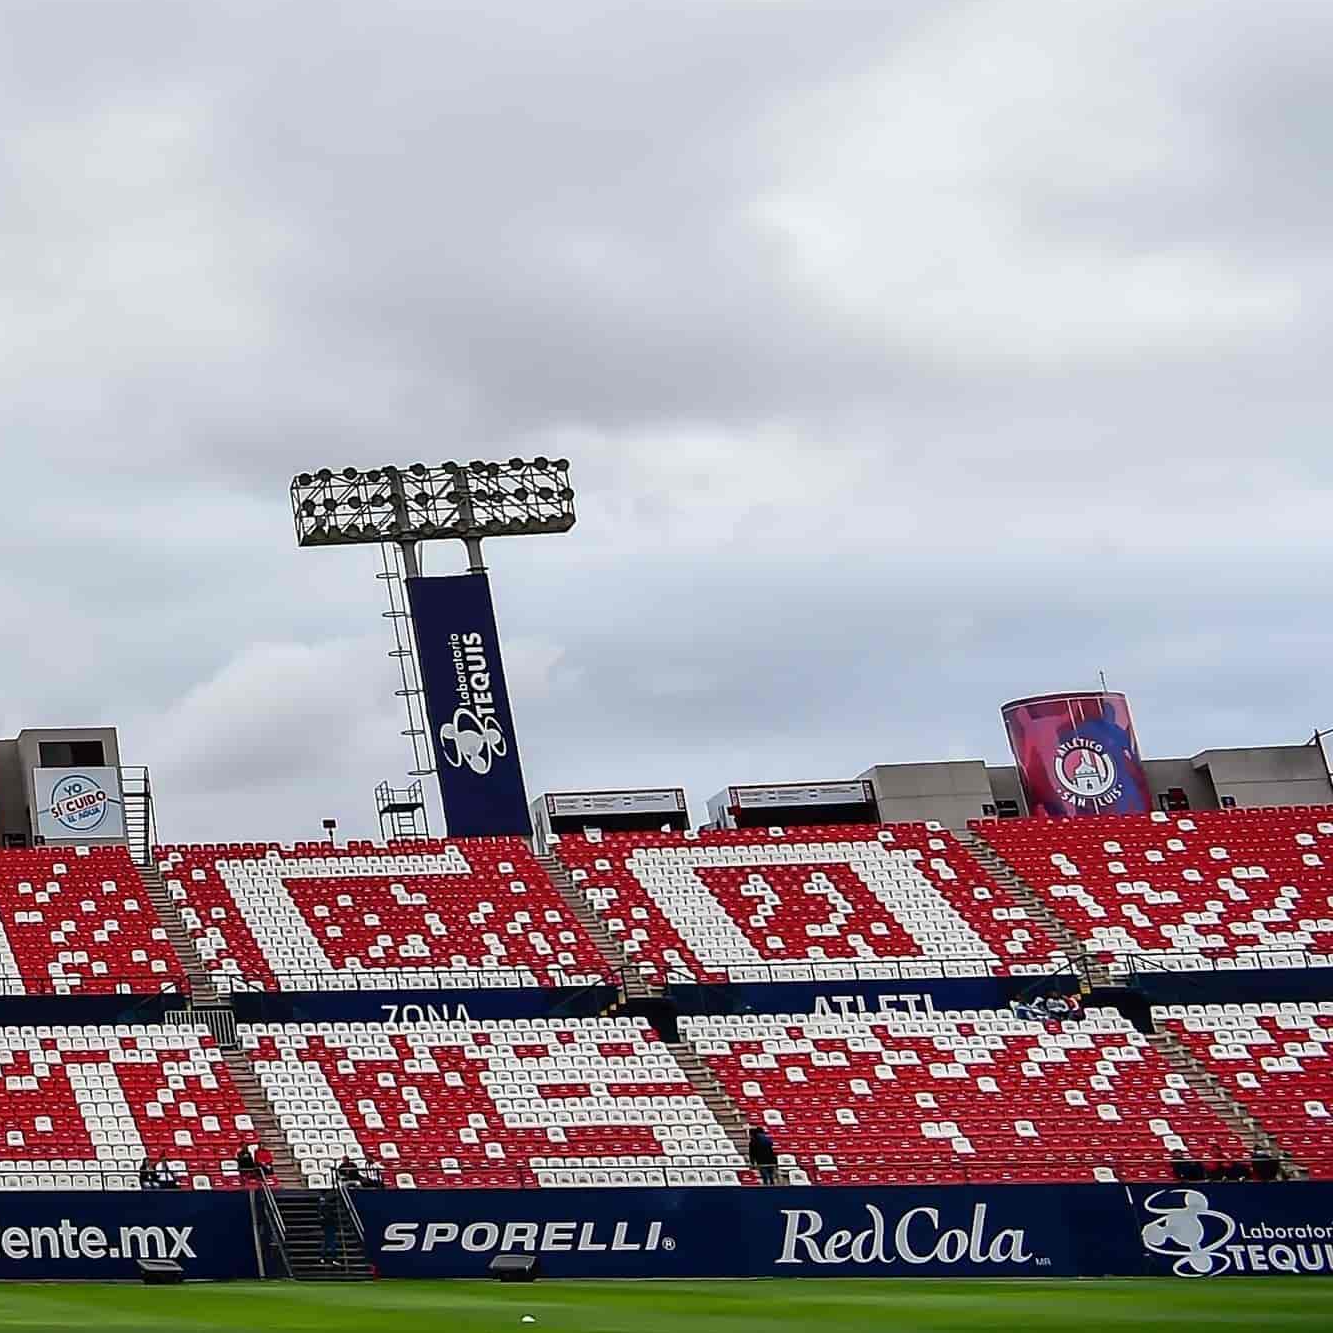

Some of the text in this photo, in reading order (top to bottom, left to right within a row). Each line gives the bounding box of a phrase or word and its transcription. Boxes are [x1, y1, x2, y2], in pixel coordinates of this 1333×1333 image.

[448, 633, 471, 706] Laboratorio
[462, 632, 495, 718] TEQUIS
[64, 783, 83, 795] YO
[66, 790, 107, 812] CUIDO
[1061, 791, 1086, 808] SAN
[1239, 1222, 1333, 1239] Laborator
